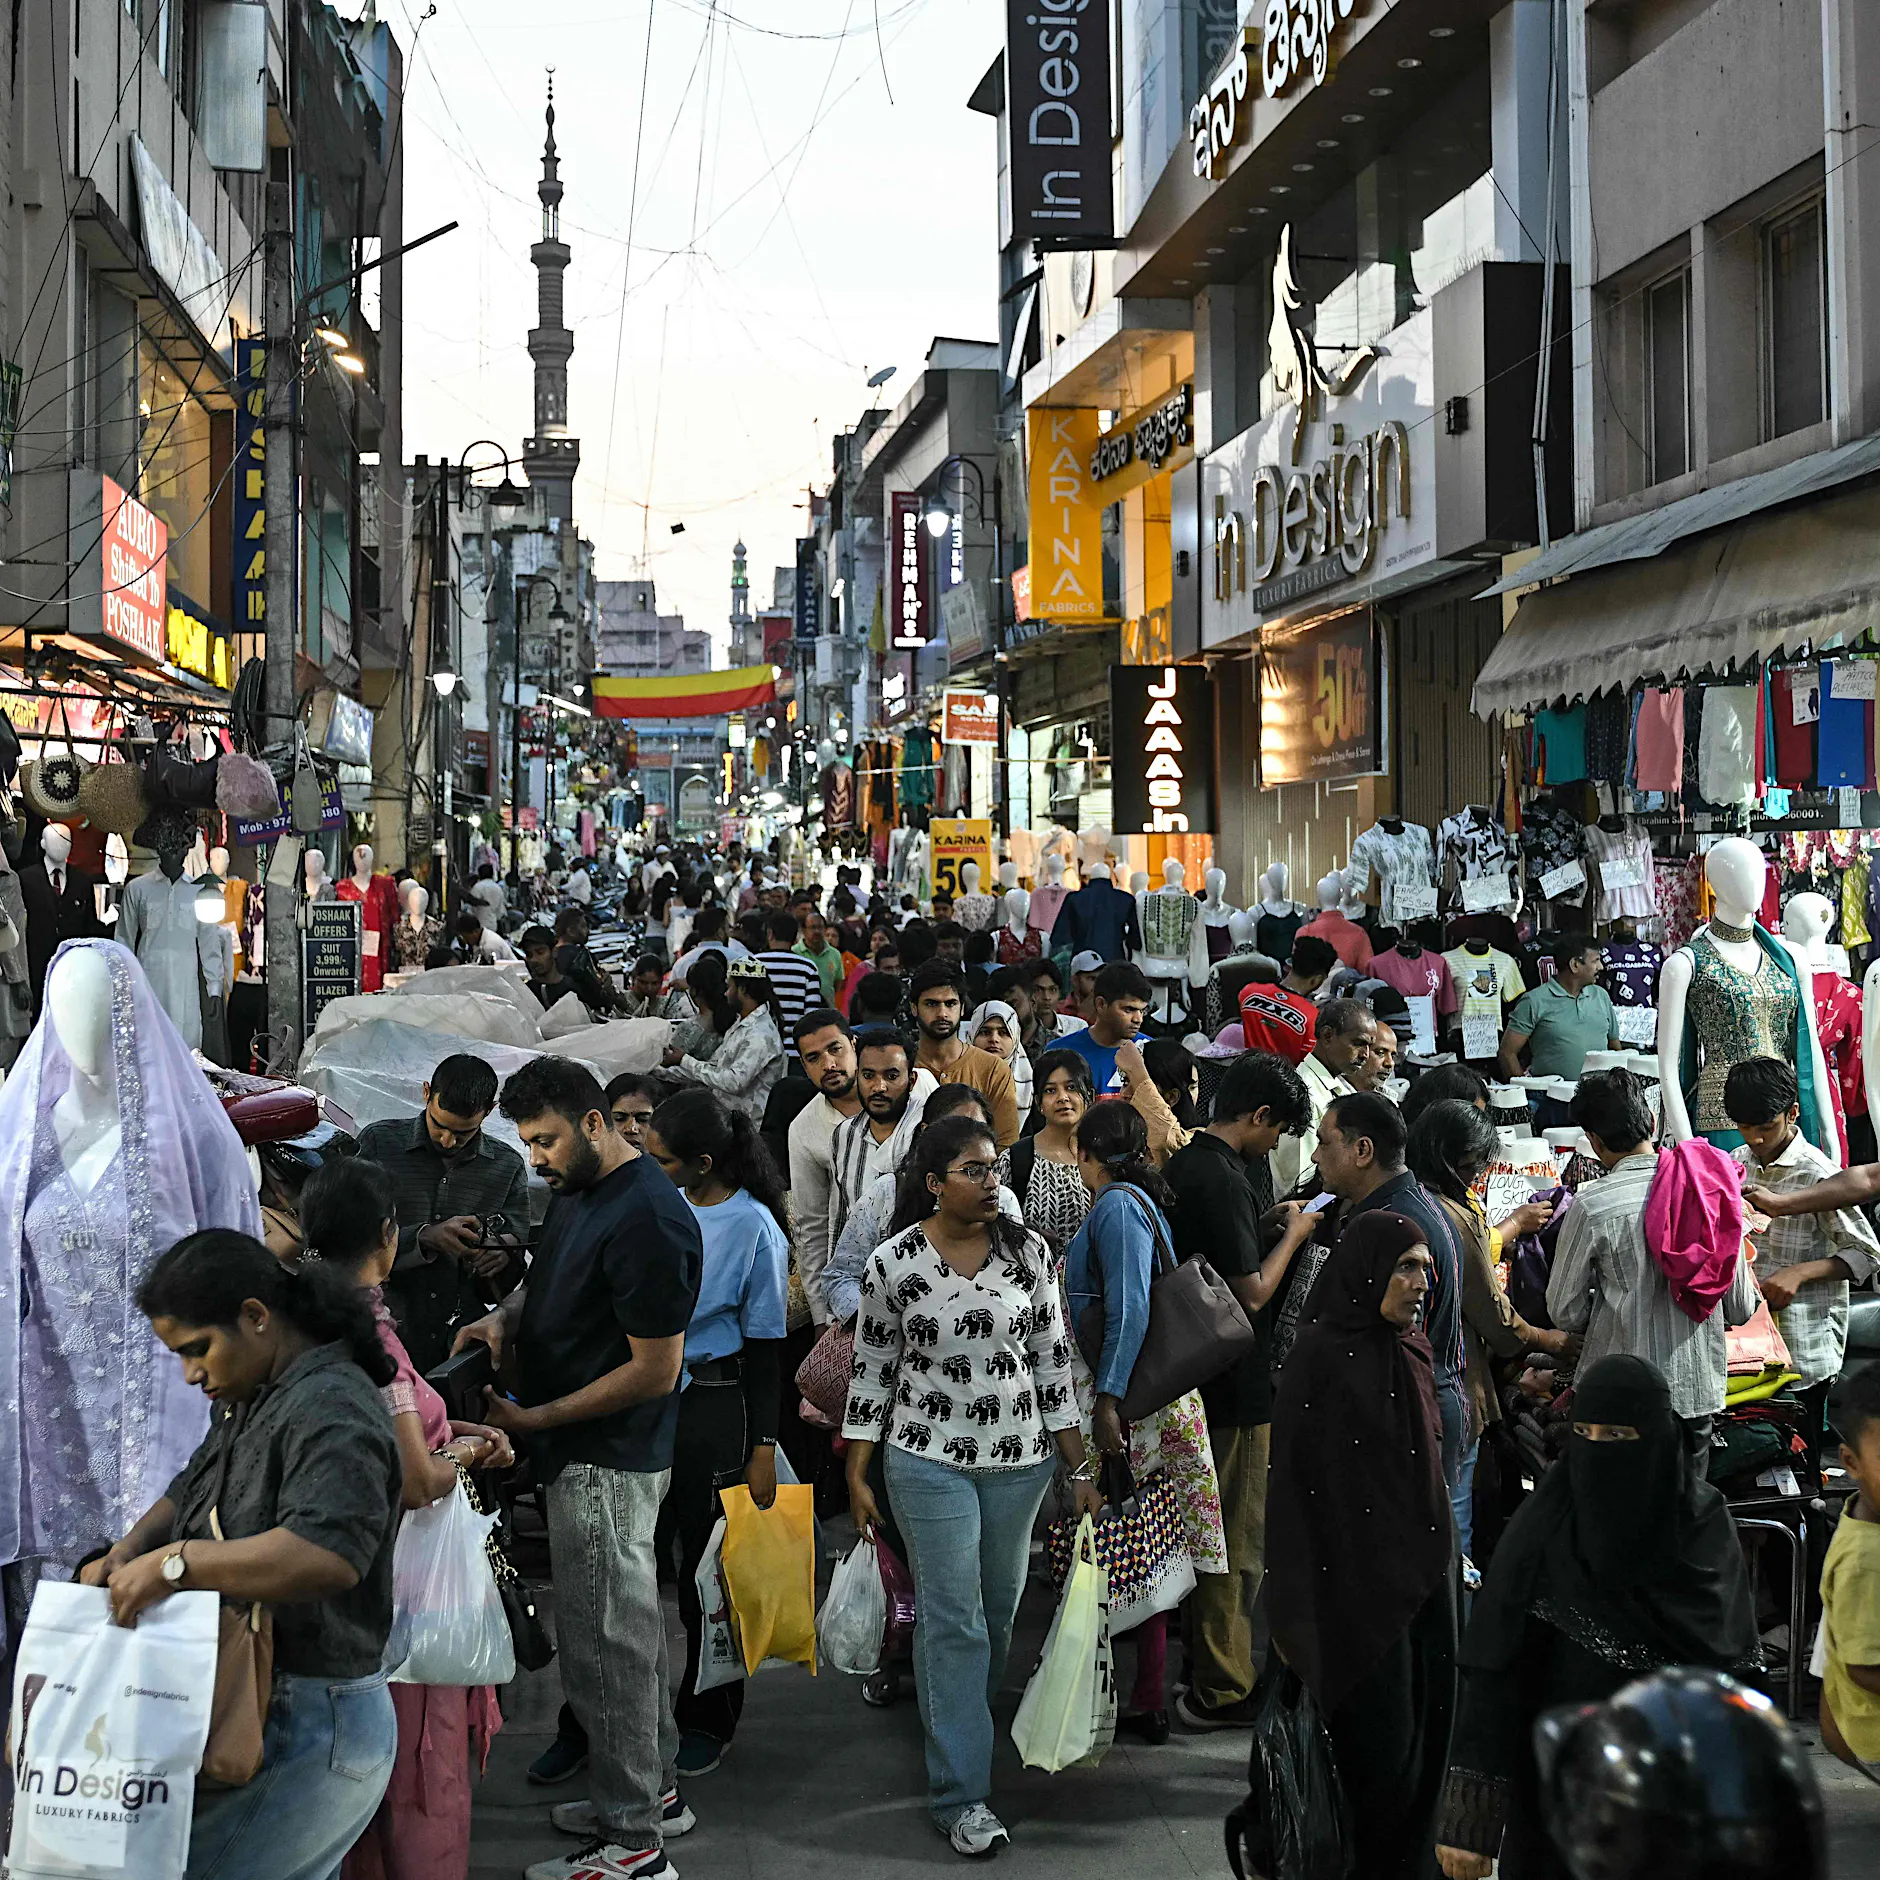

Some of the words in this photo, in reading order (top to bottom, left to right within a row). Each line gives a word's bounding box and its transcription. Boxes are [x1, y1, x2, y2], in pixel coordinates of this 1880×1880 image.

[1031, 171, 1081, 219] In
[1049, 415, 1084, 596] KARINA
[1253, 421, 1410, 582] Design
[117, 490, 156, 561] AURO
[111, 542, 148, 602] Shifted
[148, 564, 160, 610] To
[902, 512, 923, 637] REHMAN'S
[1256, 580, 1292, 609] LUXURY
[1295, 560, 1338, 593] FABRICS
[1039, 602, 1096, 613] FABRICS
[106, 591, 162, 661] POSHAAK
[239, 822, 263, 835] Mob
[934, 835, 986, 845] KARINA
[312, 910, 351, 921] POSHAAK
[314, 926, 348, 937] OFFERS
[321, 943, 341, 953] SUIT
[314, 966, 349, 977] Onwards
[1488, 963, 1499, 997] FASHION
[316, 986, 348, 996] BLAZER
[1490, 1174, 1524, 1190] LONG
[21, 1761, 44, 1794] In
[54, 1765, 168, 1810] Design
[36, 1804, 84, 1819] LUXURY
[87, 1809, 140, 1824] FABRICS
